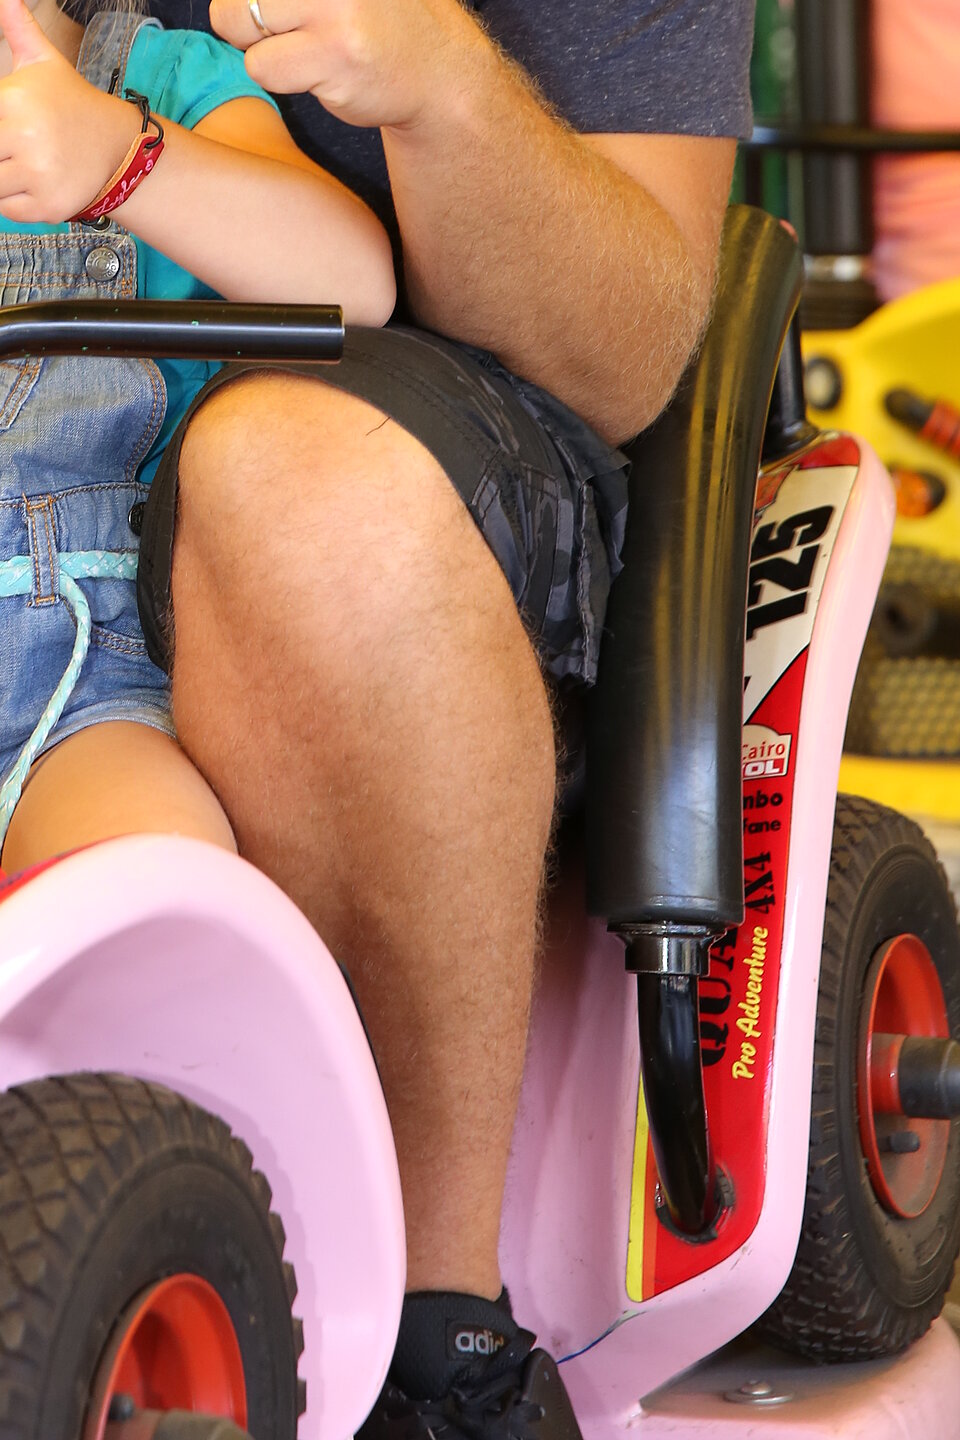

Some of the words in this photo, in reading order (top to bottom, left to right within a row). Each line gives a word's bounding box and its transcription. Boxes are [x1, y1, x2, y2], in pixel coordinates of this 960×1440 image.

[745, 505, 835, 641] 125
[744, 851, 776, 914] 4X4
[735, 925, 770, 1038] Adventure
[731, 1041, 758, 1080] Pro
